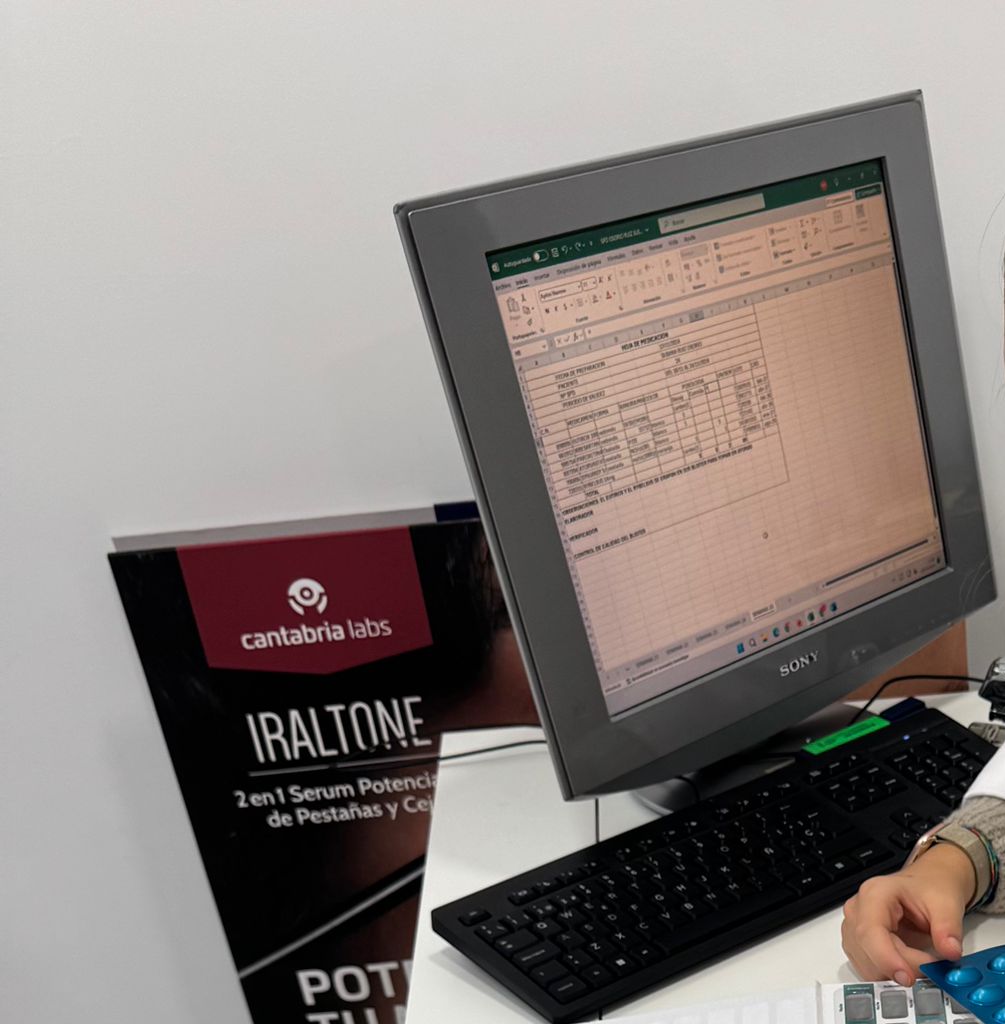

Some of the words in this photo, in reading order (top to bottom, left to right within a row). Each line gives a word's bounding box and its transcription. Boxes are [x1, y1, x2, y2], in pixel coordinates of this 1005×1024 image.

[241, 621, 345, 650] cantabria
[347, 617, 392, 639] labs
[779, 652, 817, 677] SONY
[246, 696, 432, 763] IRALTONE
[234, 790, 249, 808] 2
[249, 792, 276, 807] en
[288, 784, 355, 803] Serum
[267, 810, 293, 828] de
[295, 802, 383, 825] Pestañas
[386, 802, 398, 820] y
